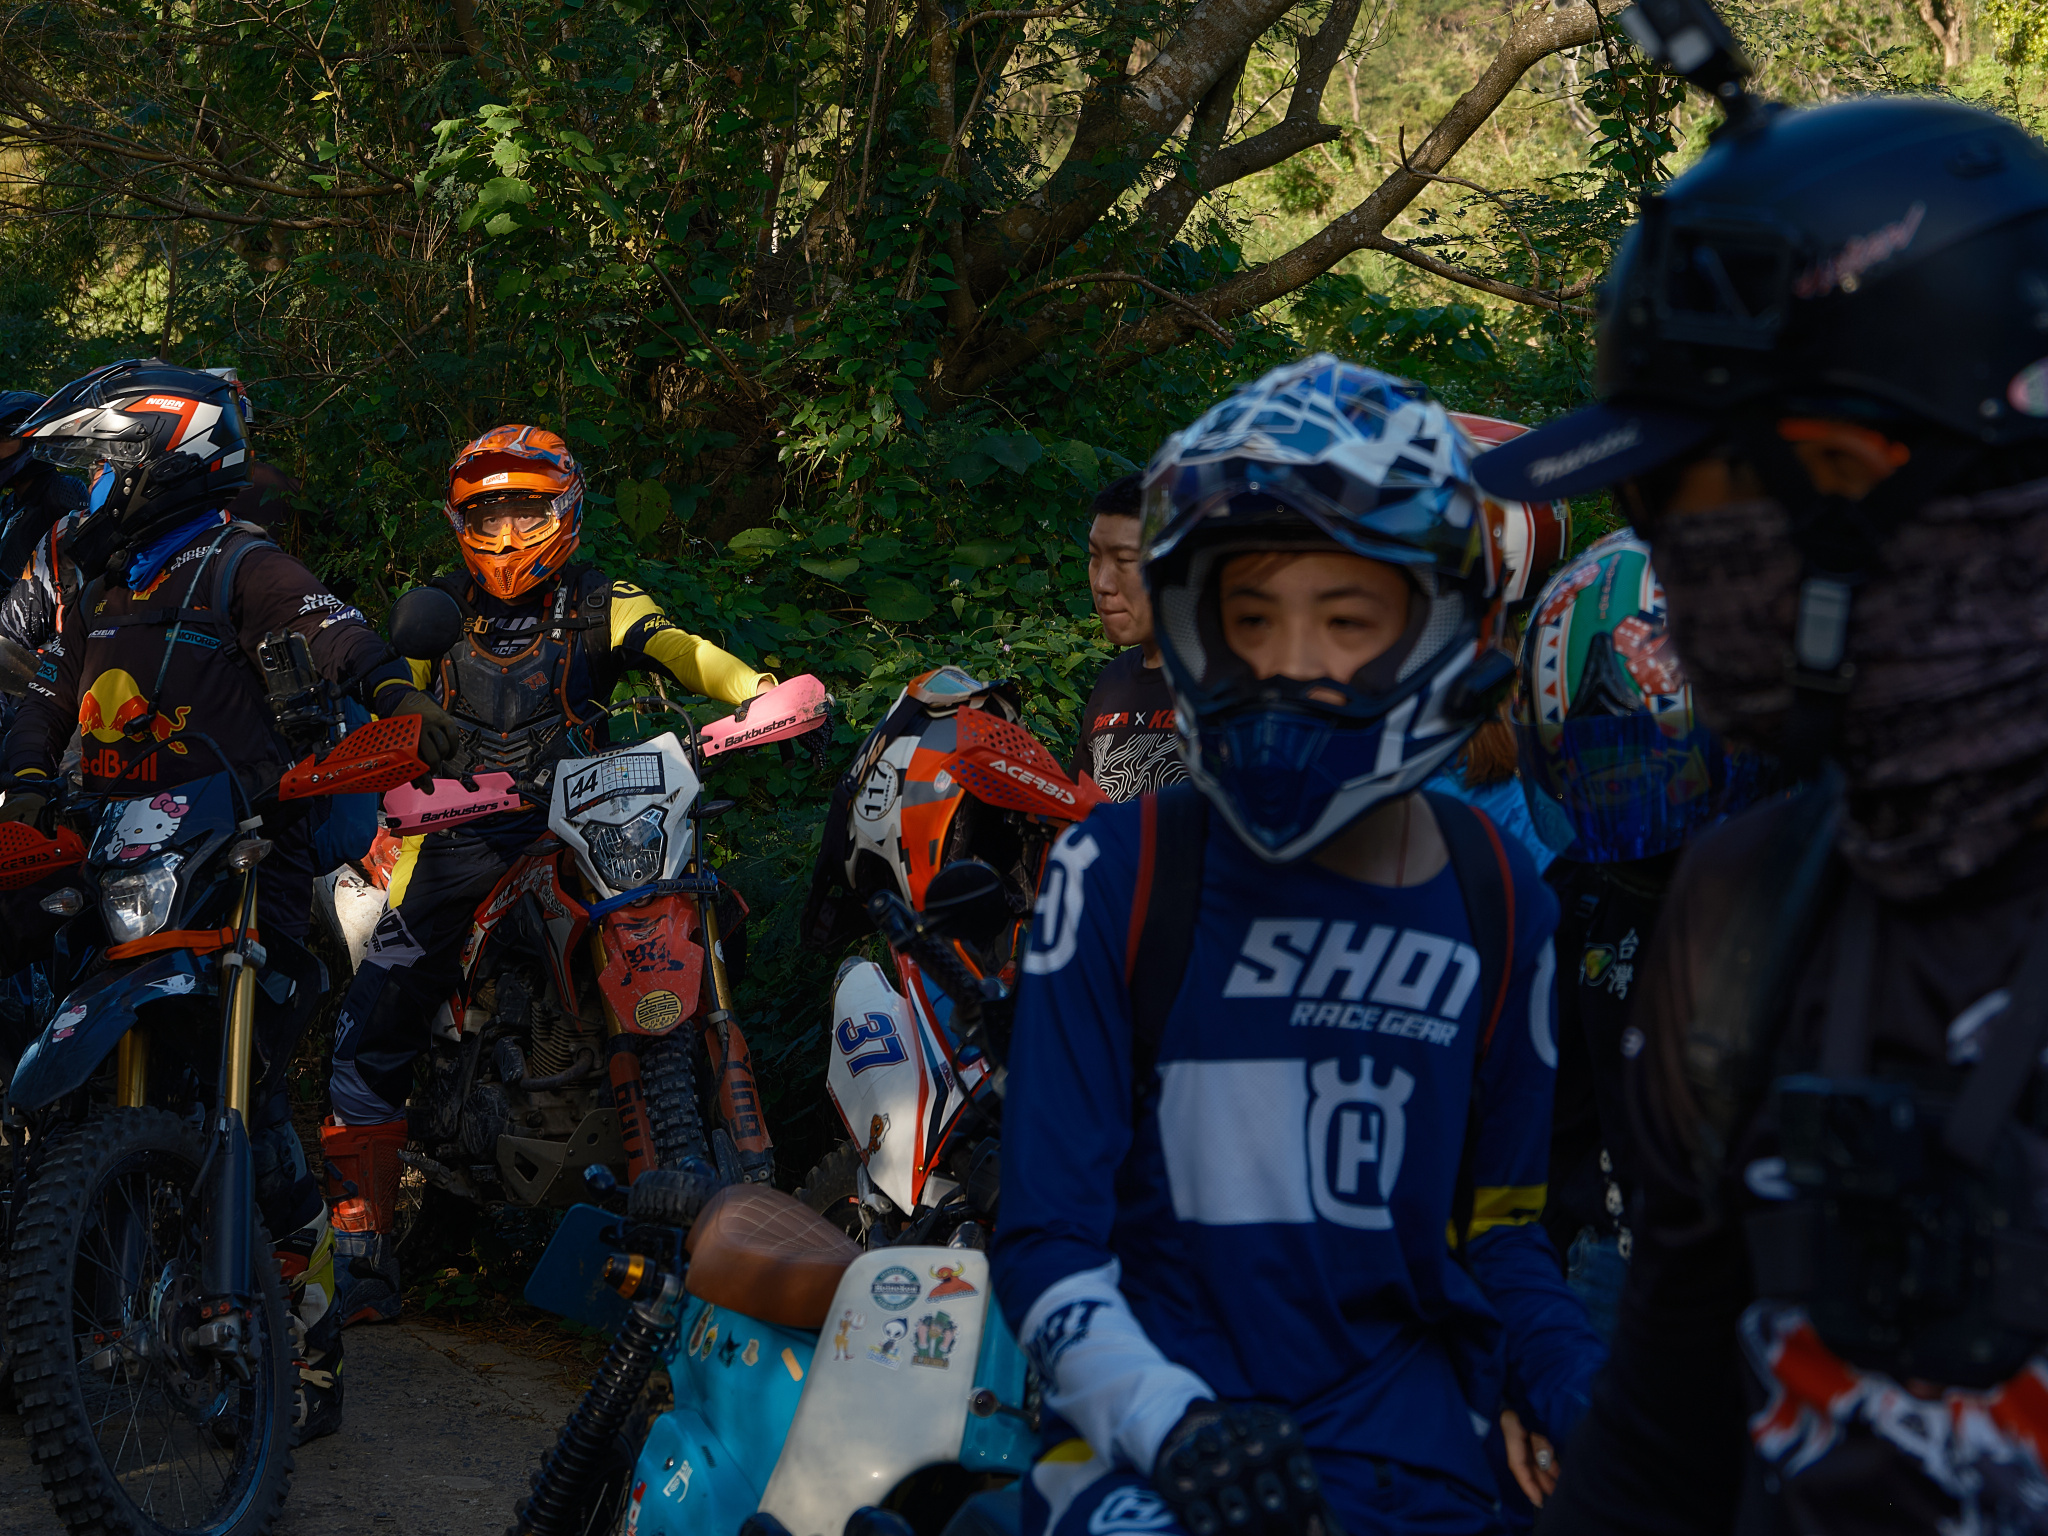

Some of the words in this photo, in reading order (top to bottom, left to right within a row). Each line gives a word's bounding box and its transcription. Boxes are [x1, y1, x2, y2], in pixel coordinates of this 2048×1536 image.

[146, 397, 185, 411] NOLAN
[179, 631, 221, 647] MOTOREX
[724, 715, 796, 749] Barkbusters
[1134, 711, 1147, 726] X
[570, 769, 599, 799] 44
[864, 765, 888, 816] 117
[989, 759, 1076, 805] ACERBIS
[420, 801, 499, 824] Barkbusters
[1, 852, 50, 870] CERBIS
[1222, 917, 1481, 1020] SHOT
[1607, 926, 1640, 1001] 台灣
[1289, 1000, 1378, 1032] RACE
[1376, 1012, 1461, 1048] GEAR
[835, 1012, 909, 1078] 37
